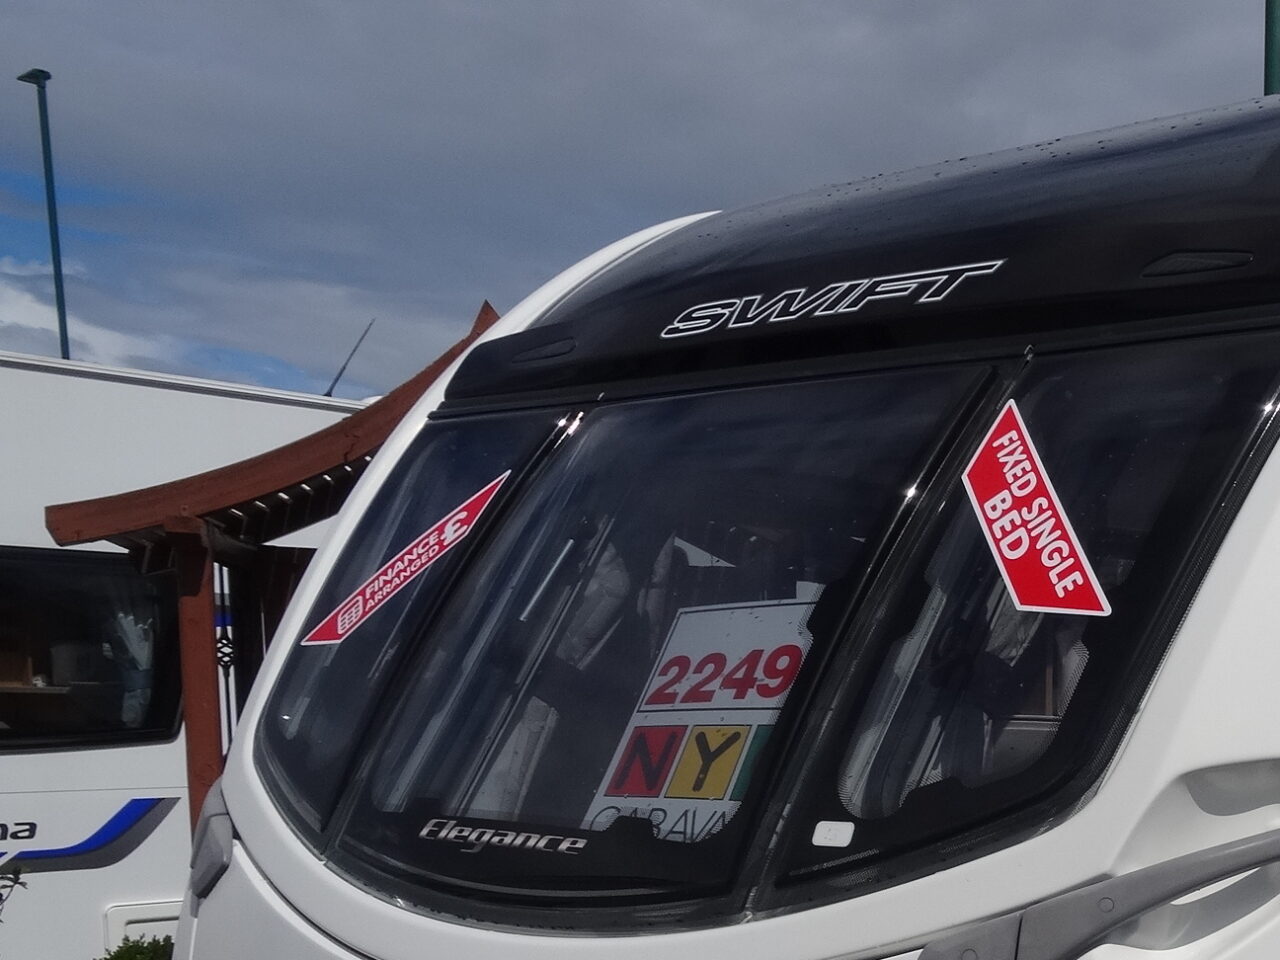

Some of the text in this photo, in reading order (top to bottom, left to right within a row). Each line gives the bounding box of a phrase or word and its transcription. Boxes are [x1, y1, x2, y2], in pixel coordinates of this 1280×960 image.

[660, 258, 1007, 338] SWIFT
[983, 489, 1030, 560] BED
[992, 429, 1084, 598] FIXED SINGLE
[364, 531, 440, 599] FINANCE
[364, 545, 440, 612] ARRANGED
[644, 644, 803, 706] 2249
[418, 818, 588, 855] Elegance
